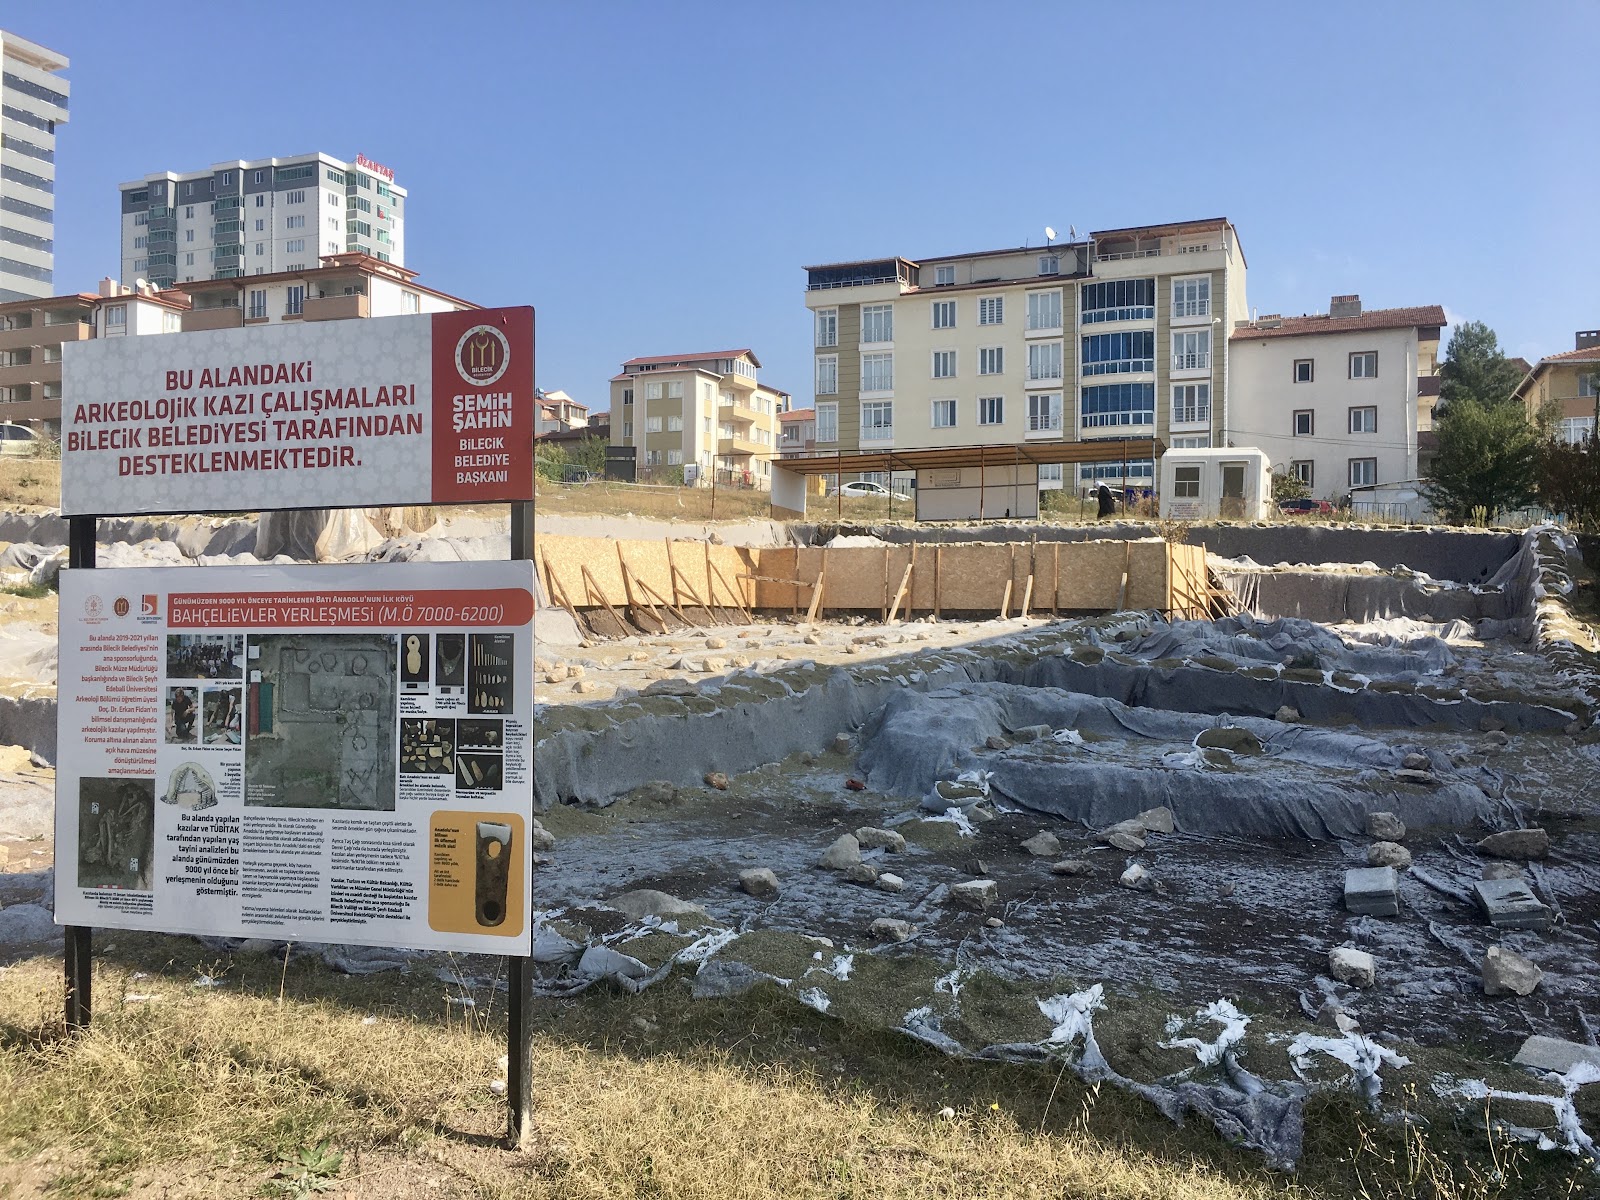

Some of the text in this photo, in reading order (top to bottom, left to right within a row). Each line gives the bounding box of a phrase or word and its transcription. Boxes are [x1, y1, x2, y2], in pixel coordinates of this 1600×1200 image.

[166, 369, 193, 391] BU
[203, 394, 254, 416] KAZI
[261, 384, 415, 418] ÇALIŞMALARI
[273, 413, 422, 441] TARAFINDAN
[456, 470, 507, 486] BAŞKANI
[378, 604, 413, 624] (M.Ö
[417, 604, 504, 623] 7000-6200)
[114, 655, 158, 663] sponsorluğunda,
[128, 665, 158, 673] Müdürlüğü
[81, 675, 118, 683] başkanlığında
[145, 675, 158, 683] Şeyh
[126, 684, 158, 692] Üniversitesi
[121, 696, 142, 704] öğretim
[113, 716, 157, 724] danışmanlığında
[126, 726, 157, 734] yapılmıştır.
[114, 757, 156, 765] dönüştürülmesi
[108, 767, 156, 775] amaçlanmaktadır.
[192, 814, 214, 822] alanda
[215, 815, 240, 823] yapılan
[177, 824, 199, 832] kazılar
[209, 824, 240, 833] TÜBİTAK
[167, 834, 201, 842] tarafından
[202, 835, 227, 844] yapılan
[179, 845, 197, 853] tayini
[199, 846, 229, 854] analizleri
[172, 854, 239, 865] alanda günümüzden
[185, 865, 239, 875] 9000 yıl önce bir
[166, 875, 238, 886] yerleşmenin olduğunu
[196, 887, 238, 897] göstermiştir.
